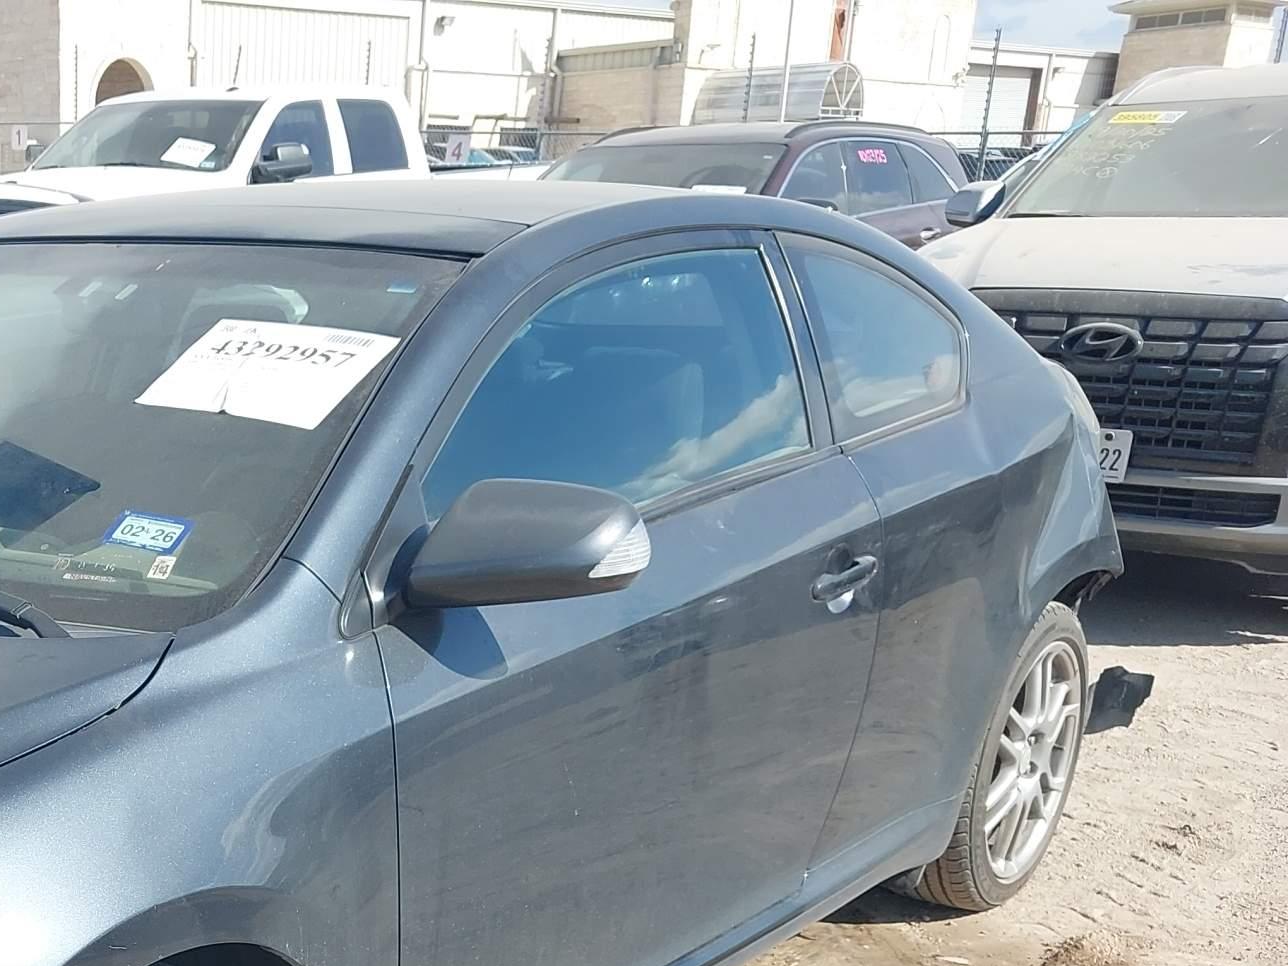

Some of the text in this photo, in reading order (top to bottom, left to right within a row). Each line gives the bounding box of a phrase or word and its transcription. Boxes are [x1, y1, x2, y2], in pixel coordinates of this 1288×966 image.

[15, 129, 21, 145] 1
[452, 141, 463, 161] 4
[211, 338, 357, 368] 43292957
[120, 524, 177, 543] 02 26
